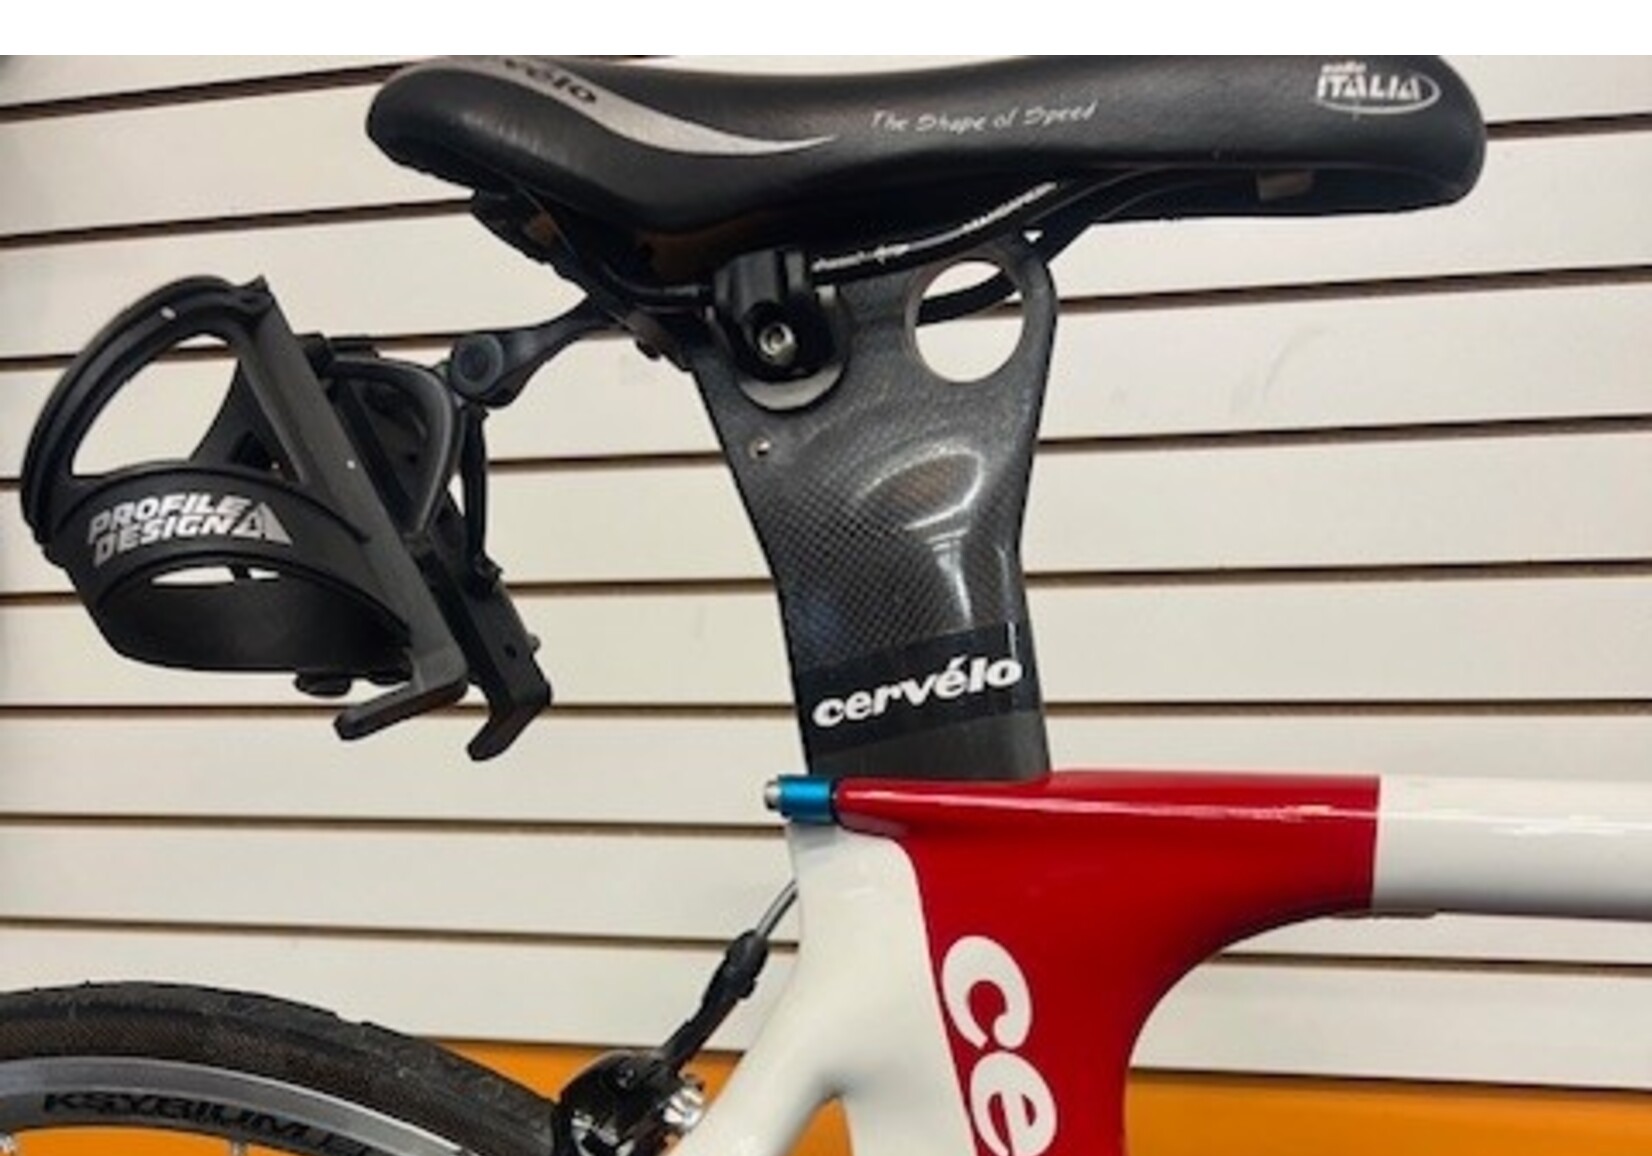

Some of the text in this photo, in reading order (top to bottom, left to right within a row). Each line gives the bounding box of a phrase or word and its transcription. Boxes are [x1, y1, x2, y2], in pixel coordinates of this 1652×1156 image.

[1317, 74, 1420, 100] ITALIA
[870, 109, 909, 132] The
[993, 105, 1021, 130] of
[1023, 98, 1099, 127] Speed
[87, 493, 253, 545] PROFILE
[93, 514, 239, 568] DESIGN
[811, 655, 1023, 728] cervélo
